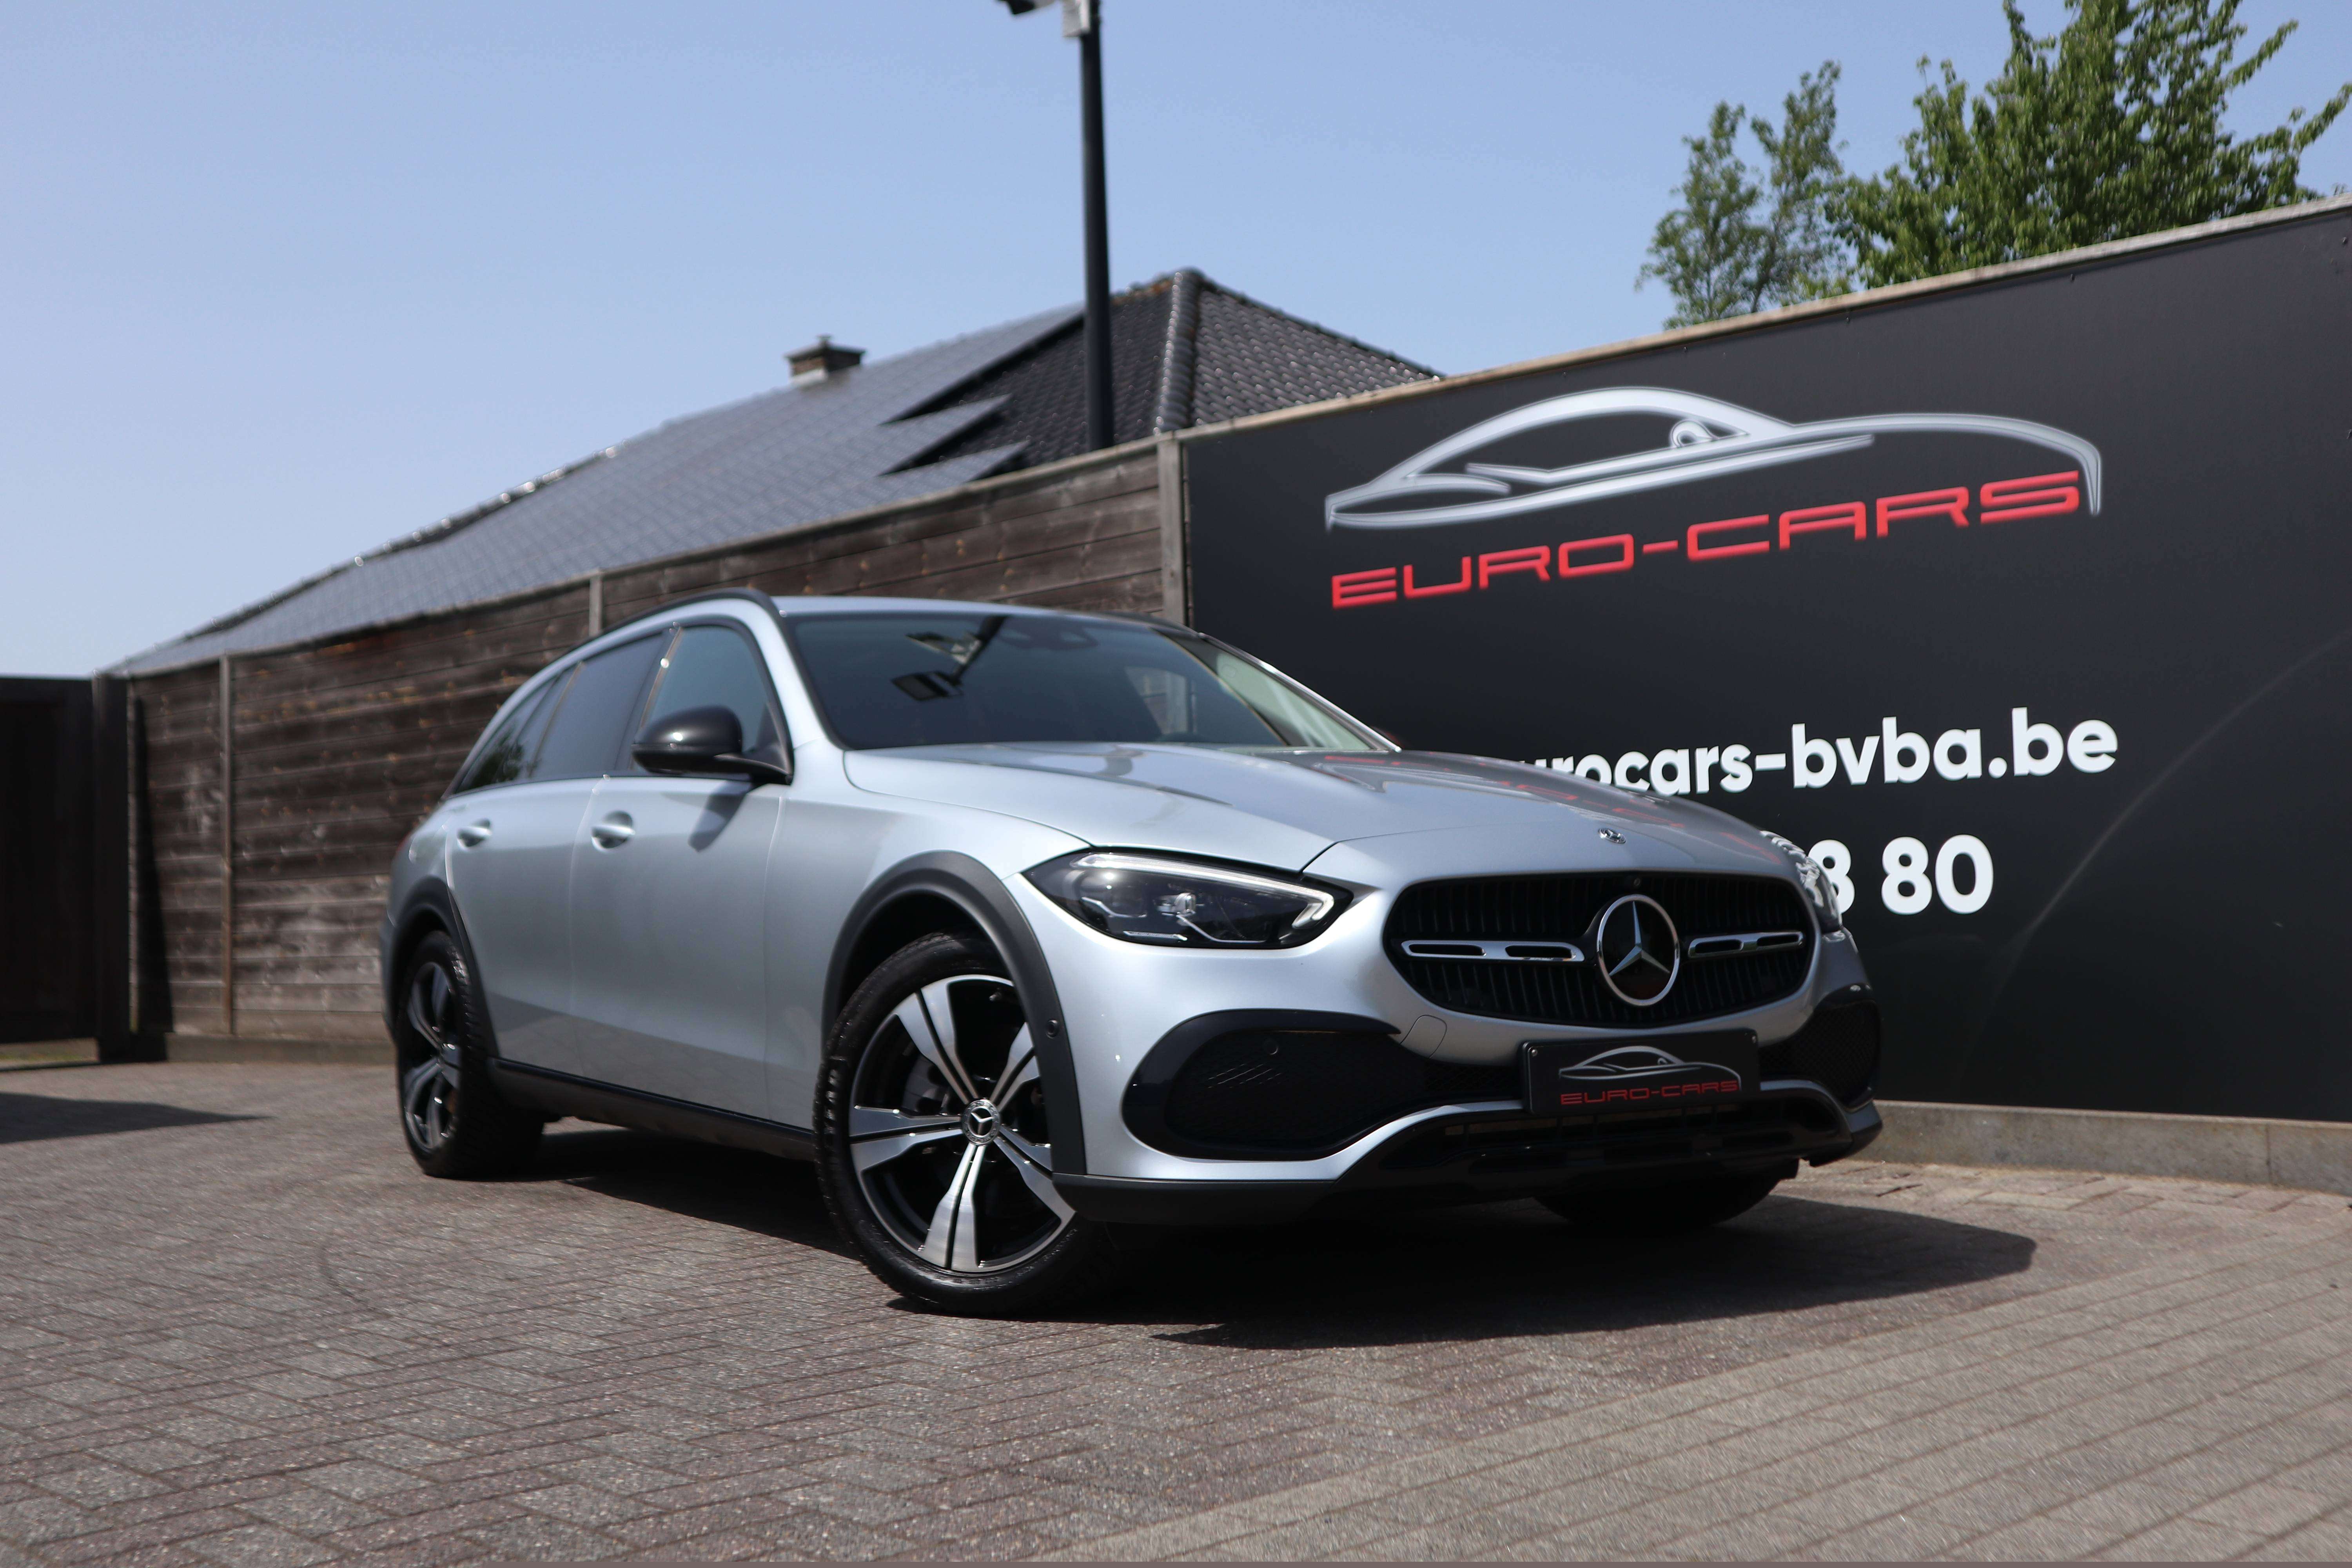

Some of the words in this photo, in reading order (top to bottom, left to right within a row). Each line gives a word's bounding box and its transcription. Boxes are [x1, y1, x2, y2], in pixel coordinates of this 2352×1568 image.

[1330, 469, 2081, 609] EURO-CARS
[1519, 707, 2118, 796] ocars-bvba.be
[1881, 834, 1994, 915] 80
[1560, 1080, 1739, 1105] EURO-CARS
